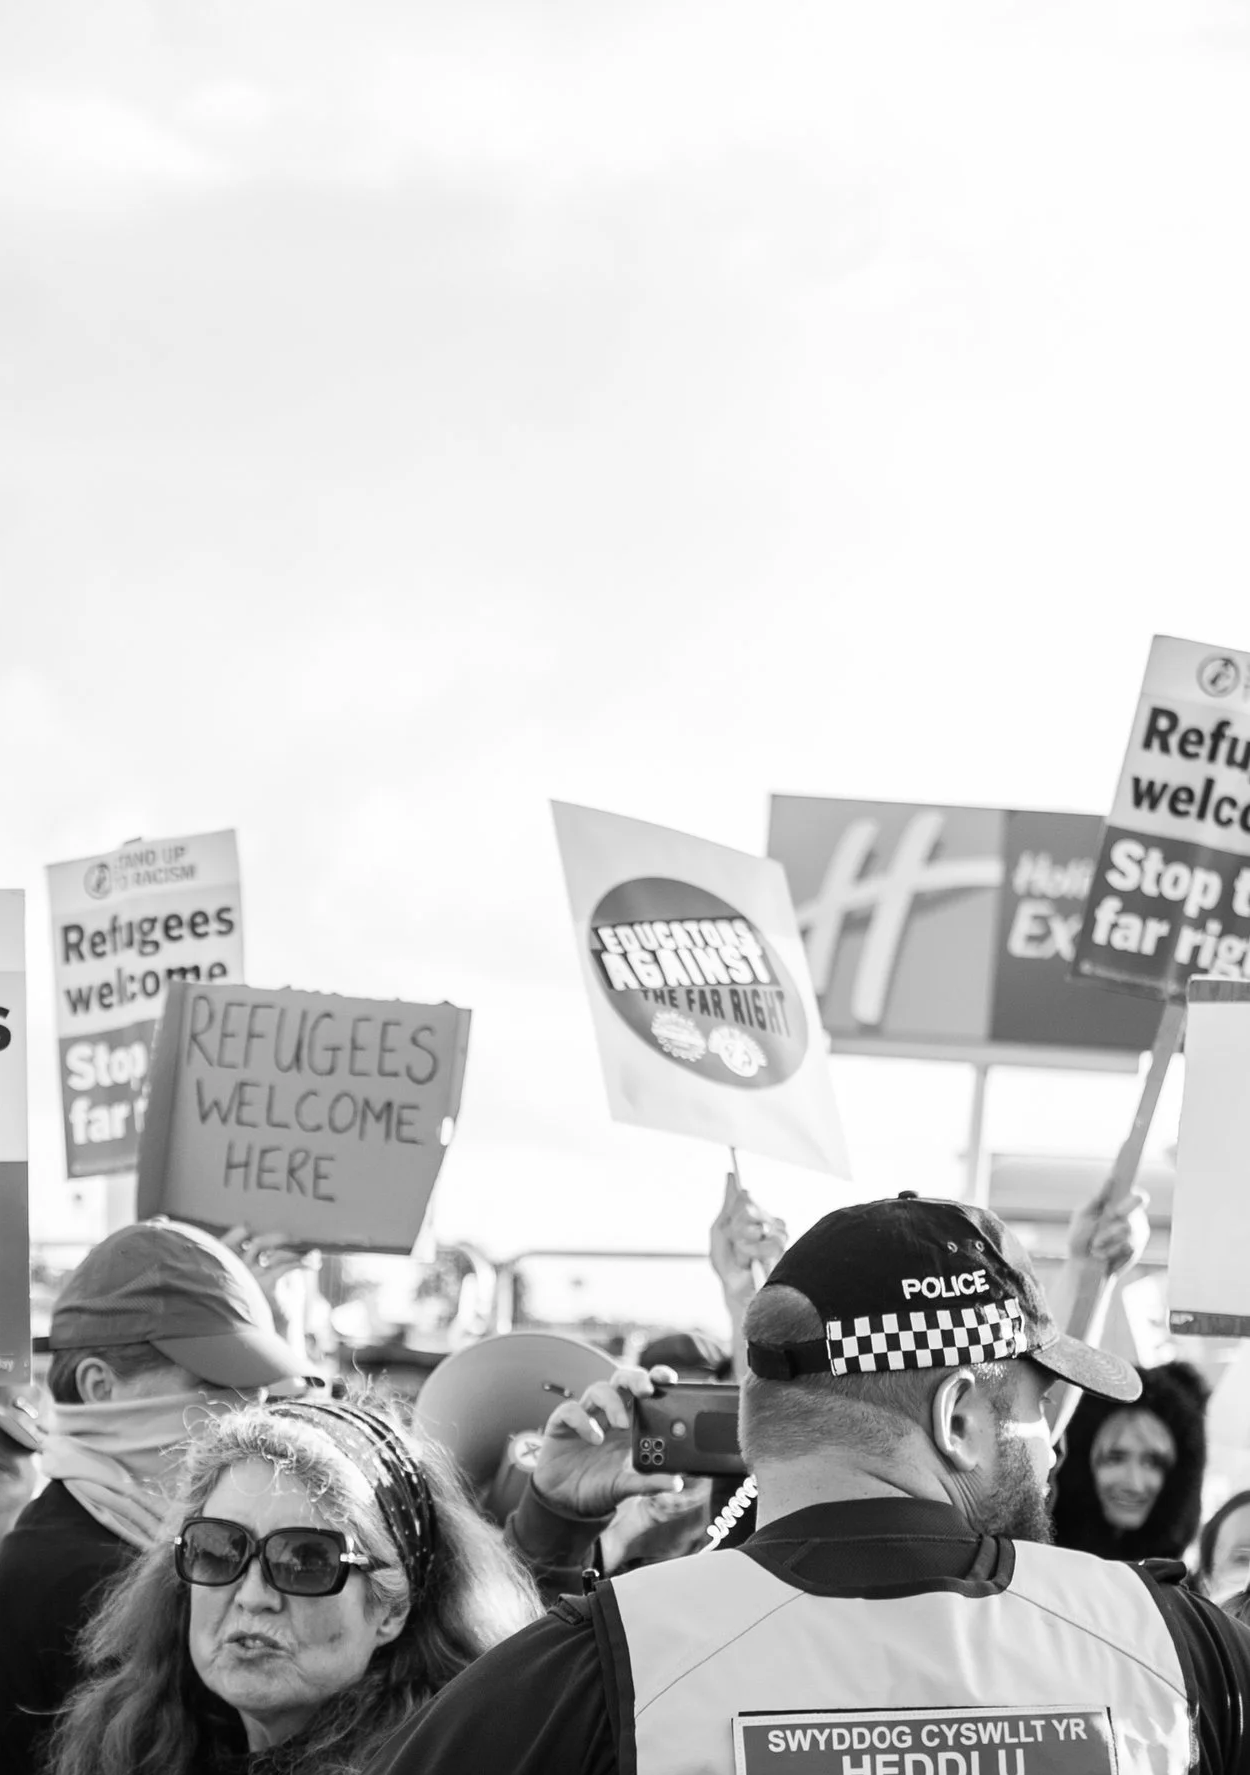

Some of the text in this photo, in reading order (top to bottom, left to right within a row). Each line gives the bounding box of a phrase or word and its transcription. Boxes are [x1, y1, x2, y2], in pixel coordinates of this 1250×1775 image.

[1142, 706, 1250, 775] Refu
[113, 851, 155, 869] TAND
[1105, 838, 1222, 918] Stop
[61, 907, 234, 965] Refugees
[598, 918, 754, 954] EDUCATORS
[1092, 895, 1170, 956] far
[601, 946, 771, 991] AGAINST
[641, 989, 679, 1008] THE
[686, 989, 726, 1020] FAR
[730, 989, 791, 1038] RIGHT
[187, 996, 439, 1085] REFUGEES
[69, 1096, 128, 1145] far
[196, 1078, 424, 1145] WELCOME
[224, 1140, 336, 1202] HERE
[902, 1269, 990, 1300] POLICE
[768, 1718, 1087, 1753] SWYDDOG CYSWLLT YR
